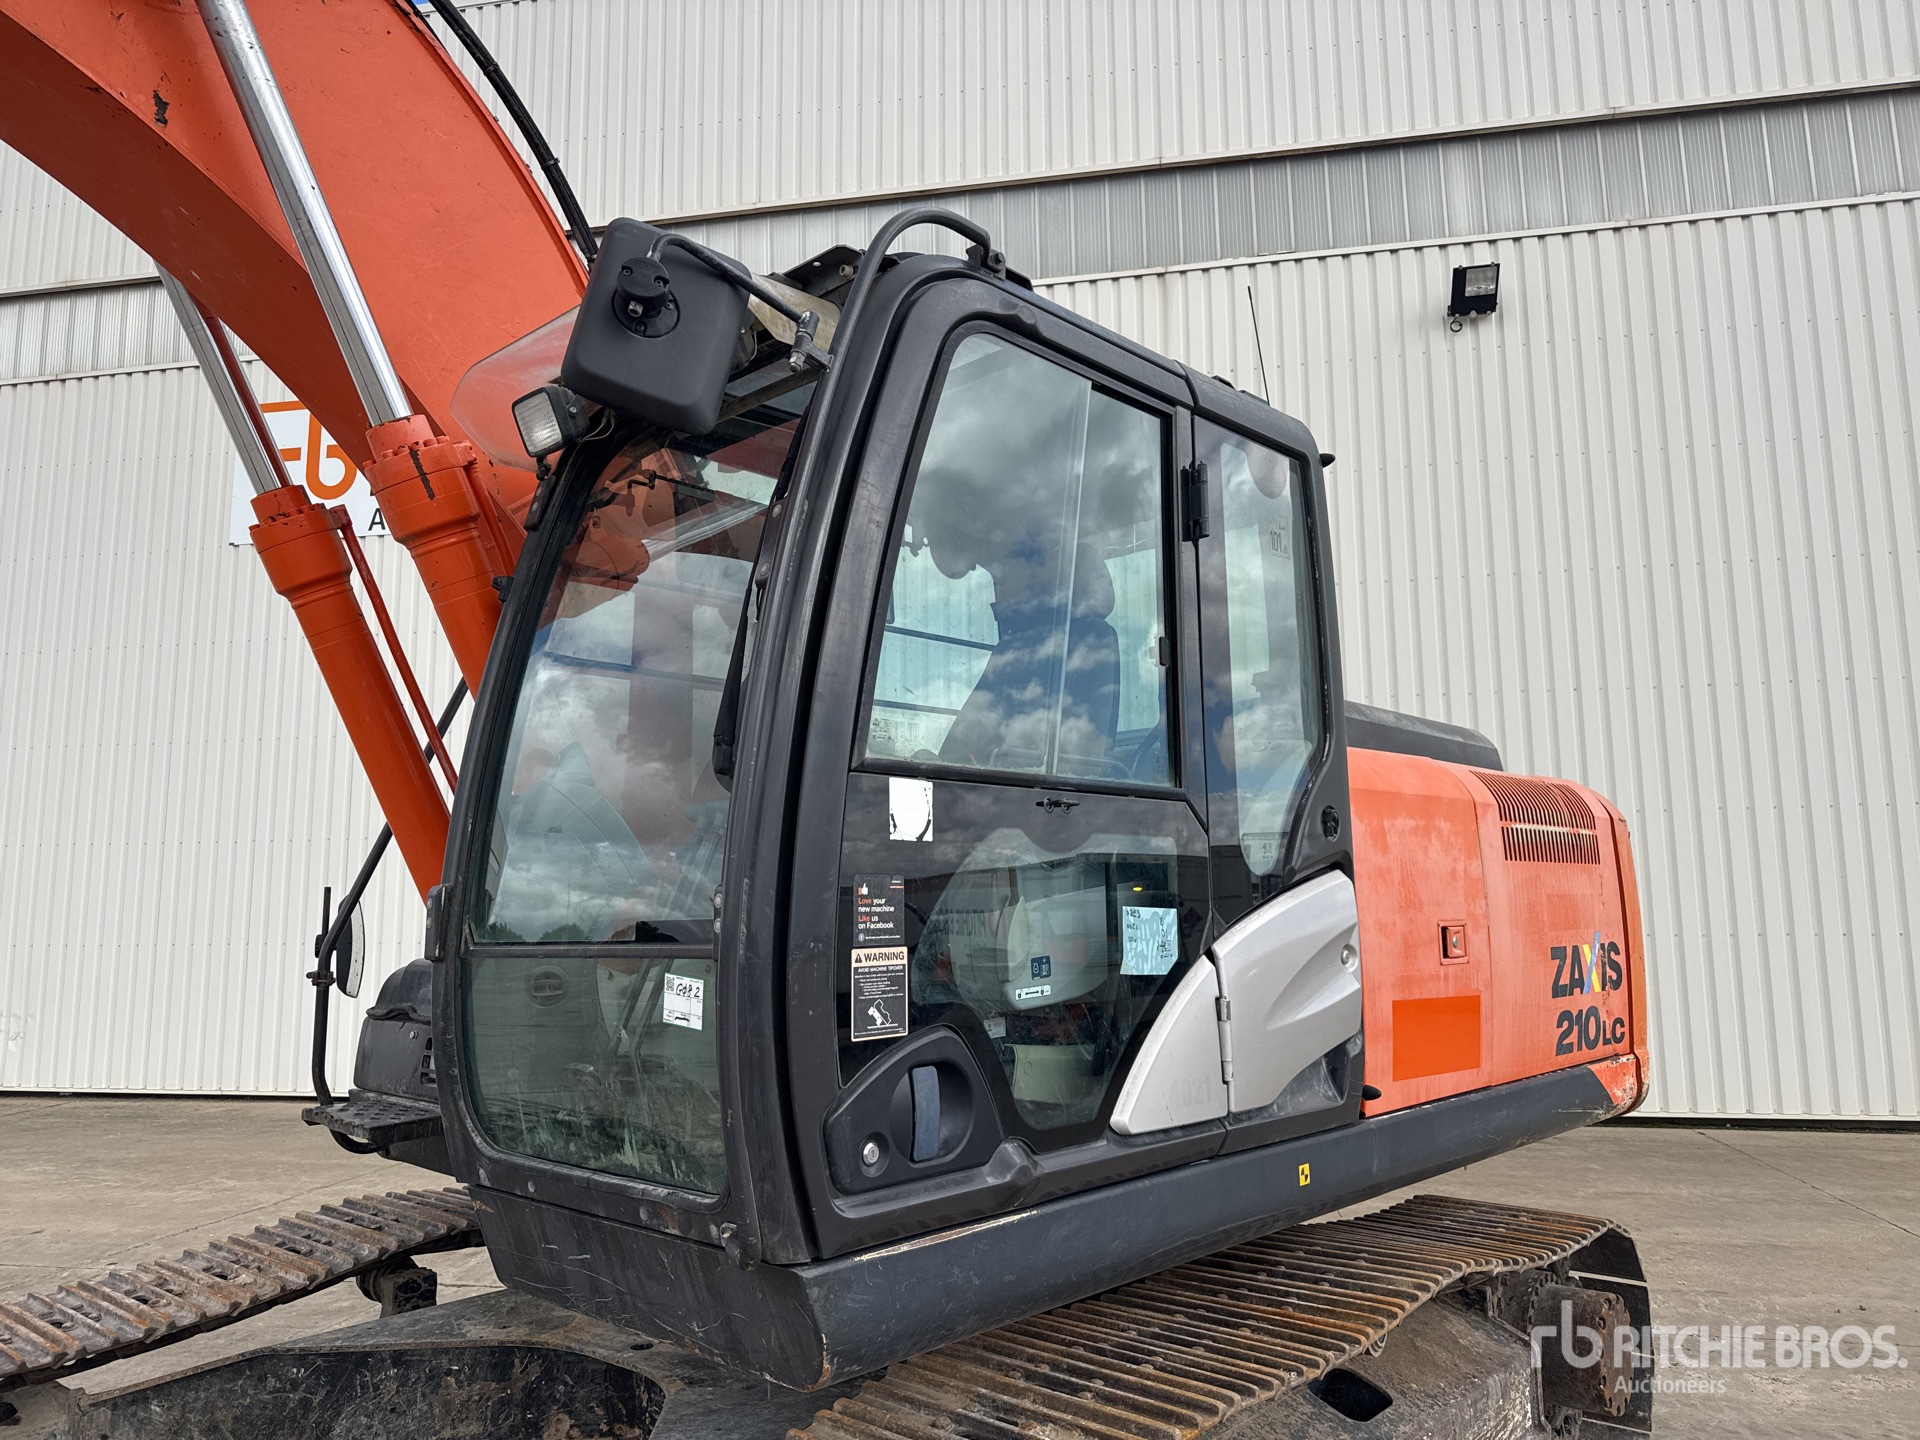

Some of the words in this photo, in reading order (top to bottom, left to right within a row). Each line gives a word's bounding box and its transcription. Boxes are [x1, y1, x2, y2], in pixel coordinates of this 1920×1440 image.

[1269, 530, 1282, 553] 101
[858, 897, 872, 905] Love
[873, 898, 886, 906] your
[866, 921, 894, 929] Facebook
[864, 951, 905, 963] WARNING
[1550, 930, 1623, 998] ZAXIS
